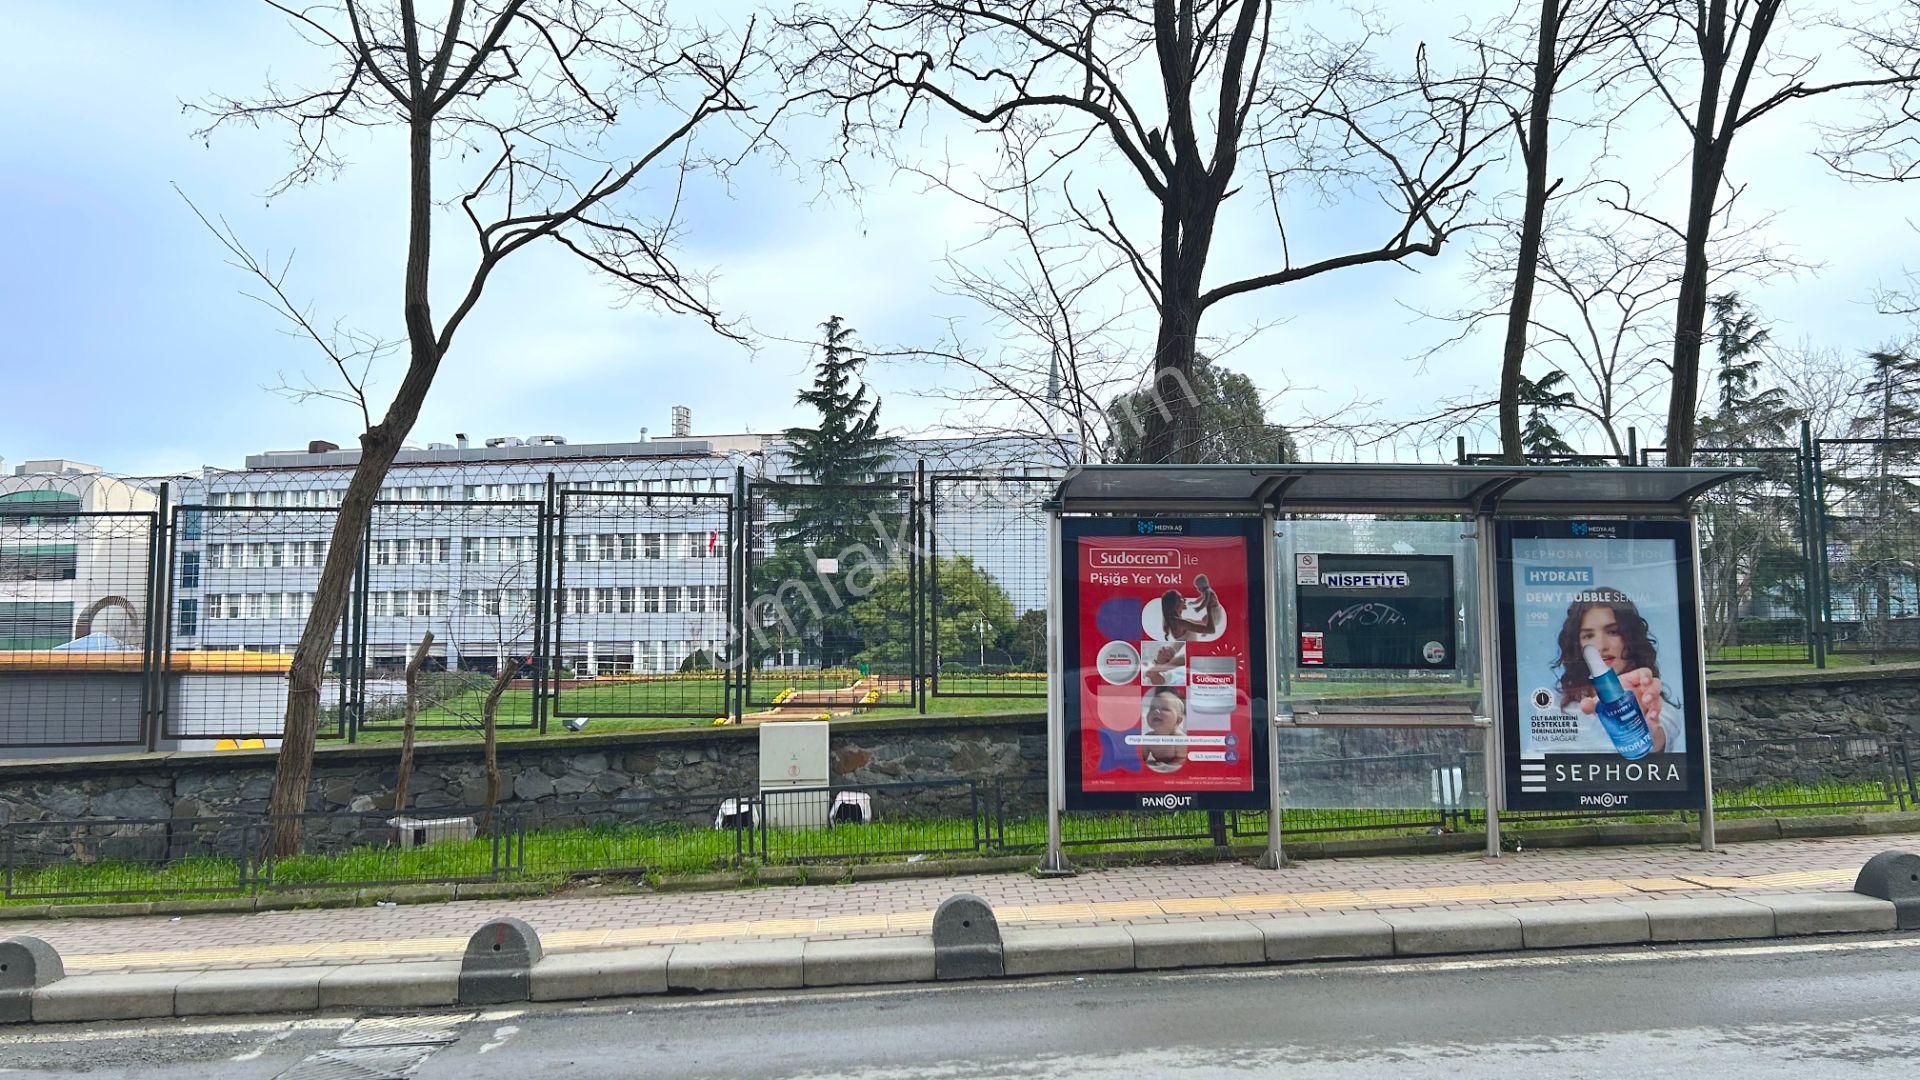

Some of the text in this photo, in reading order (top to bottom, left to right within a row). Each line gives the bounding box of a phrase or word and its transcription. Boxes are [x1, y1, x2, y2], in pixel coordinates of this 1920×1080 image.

[1100, 552, 1199, 566] Sudocrem ile
[1524, 550, 1582, 560] SEPHORA
[1090, 572, 1182, 586] Pişiğe Yer Yok!
[1328, 573, 1405, 586] NİSPETİYE
[1529, 571, 1589, 582] HYDRATE
[1526, 592, 1649, 603] DEWY BUBBLE SERUM
[1555, 763, 1680, 782] SEPHORA
[1142, 793, 1192, 809] PANOUT
[1580, 792, 1628, 807] PANOUT
